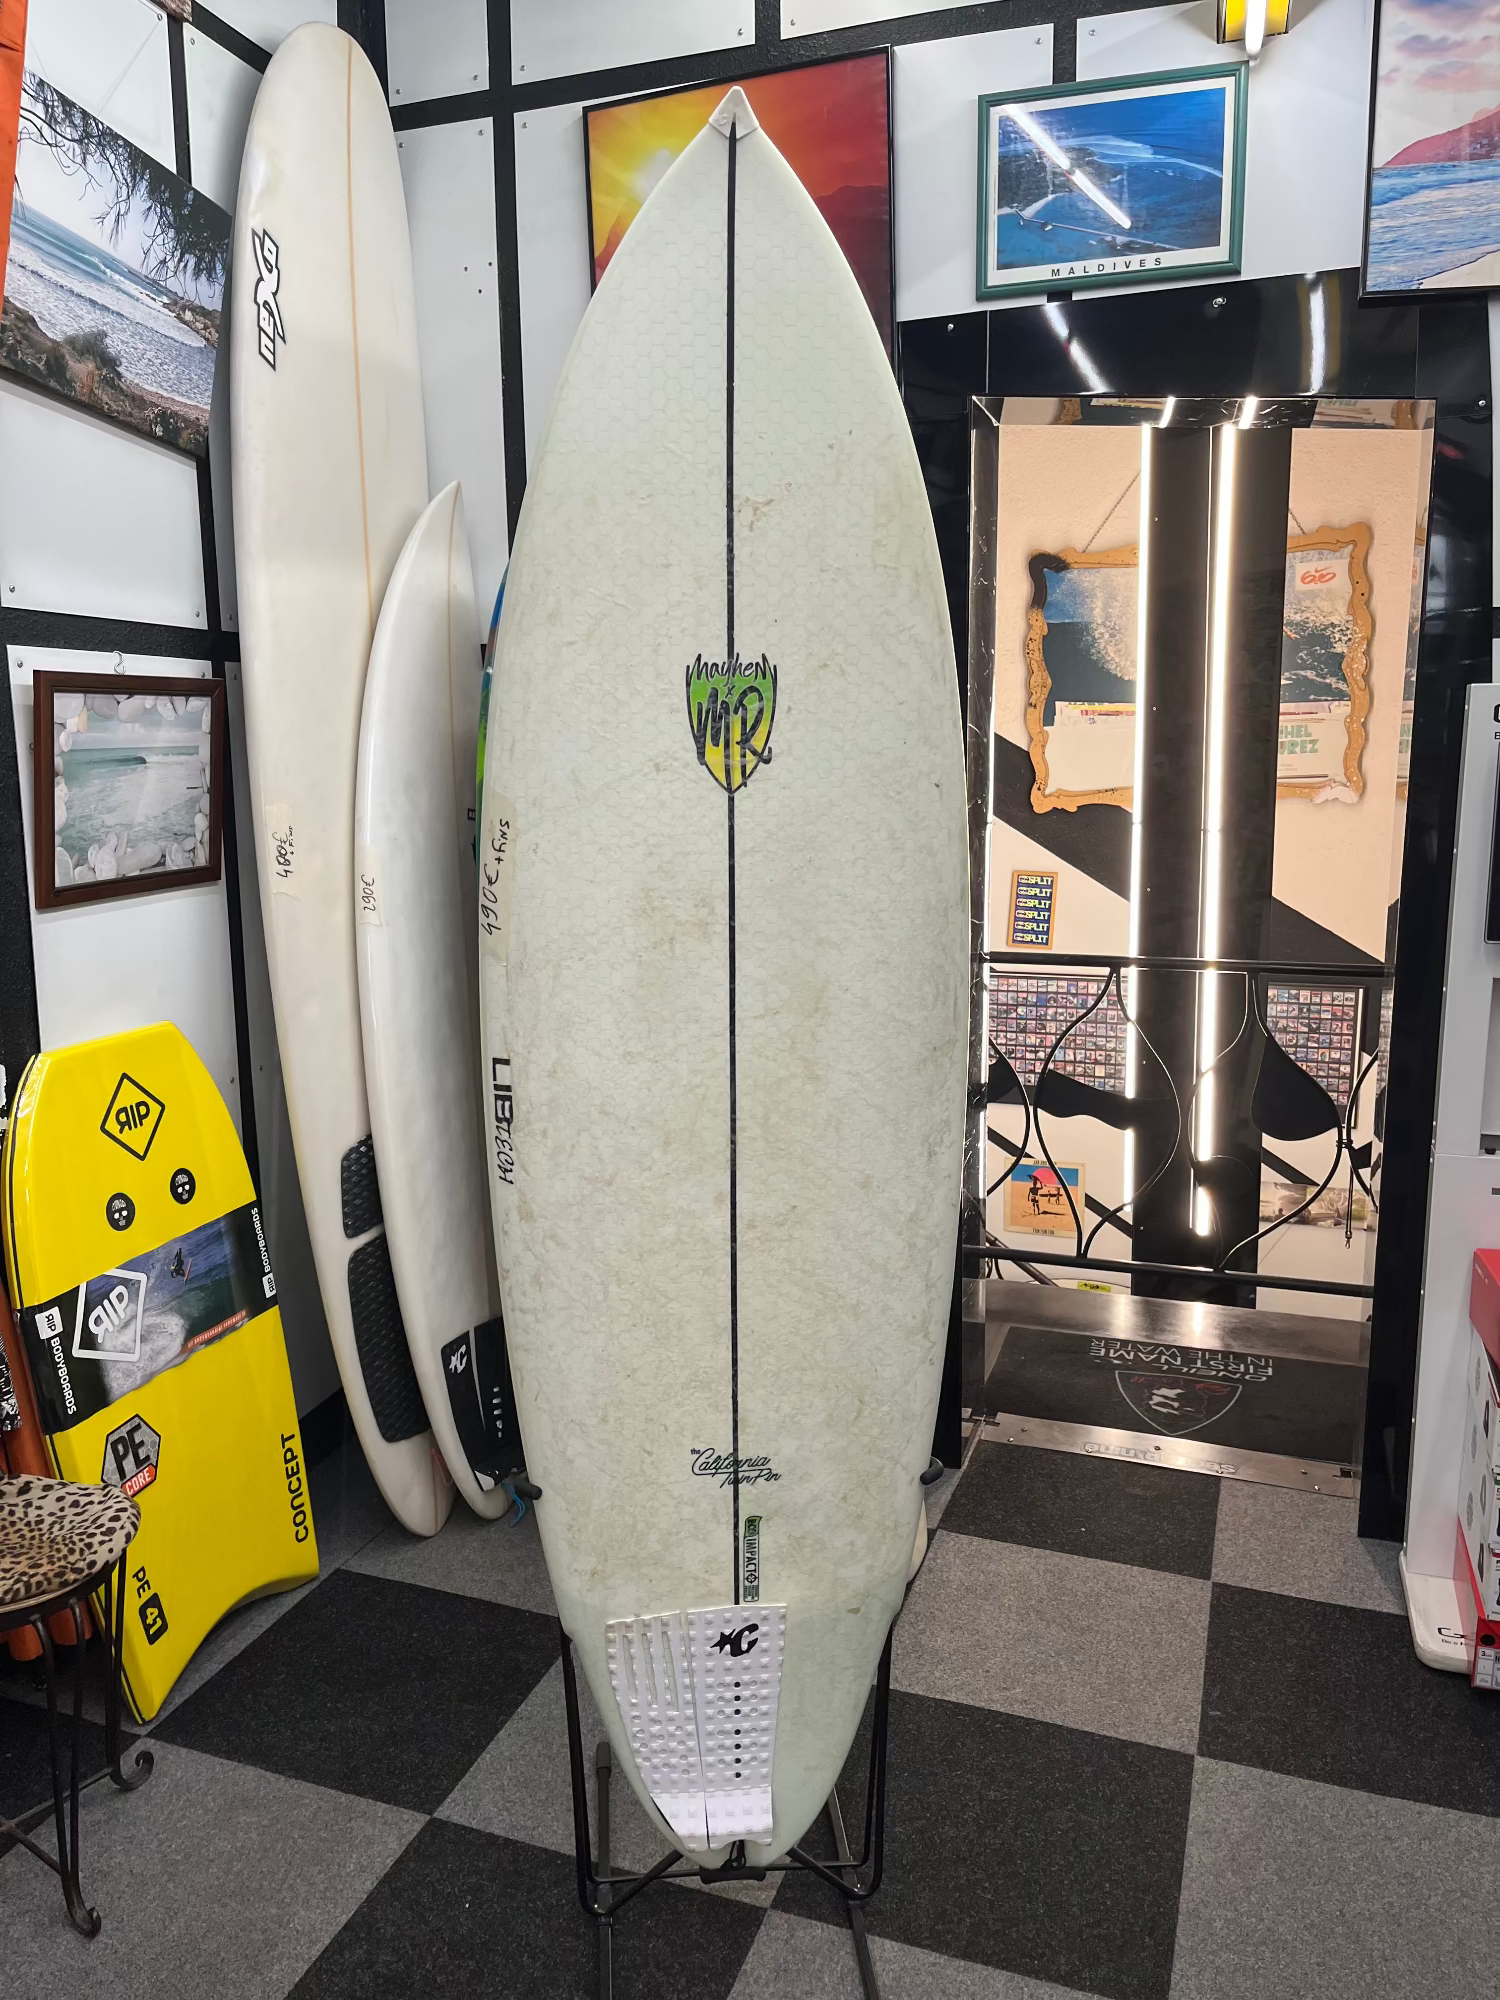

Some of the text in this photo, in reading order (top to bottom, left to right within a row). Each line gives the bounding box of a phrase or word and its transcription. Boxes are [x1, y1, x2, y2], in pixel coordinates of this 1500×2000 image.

[1051, 257, 1162, 277] MALDIVES
[251, 1207, 271, 1273] BODYBOARDS
[1090, 1346, 1273, 1376] FIRST NAME
[1091, 1338, 1273, 1367] IN THE WATER
[51, 1336, 77, 1415] BODYBOARDS
[110, 1422, 151, 1481] PE
[692, 1448, 771, 1478] California
[125, 1467, 152, 1496] CORE
[132, 1566, 163, 1635] PE 41
